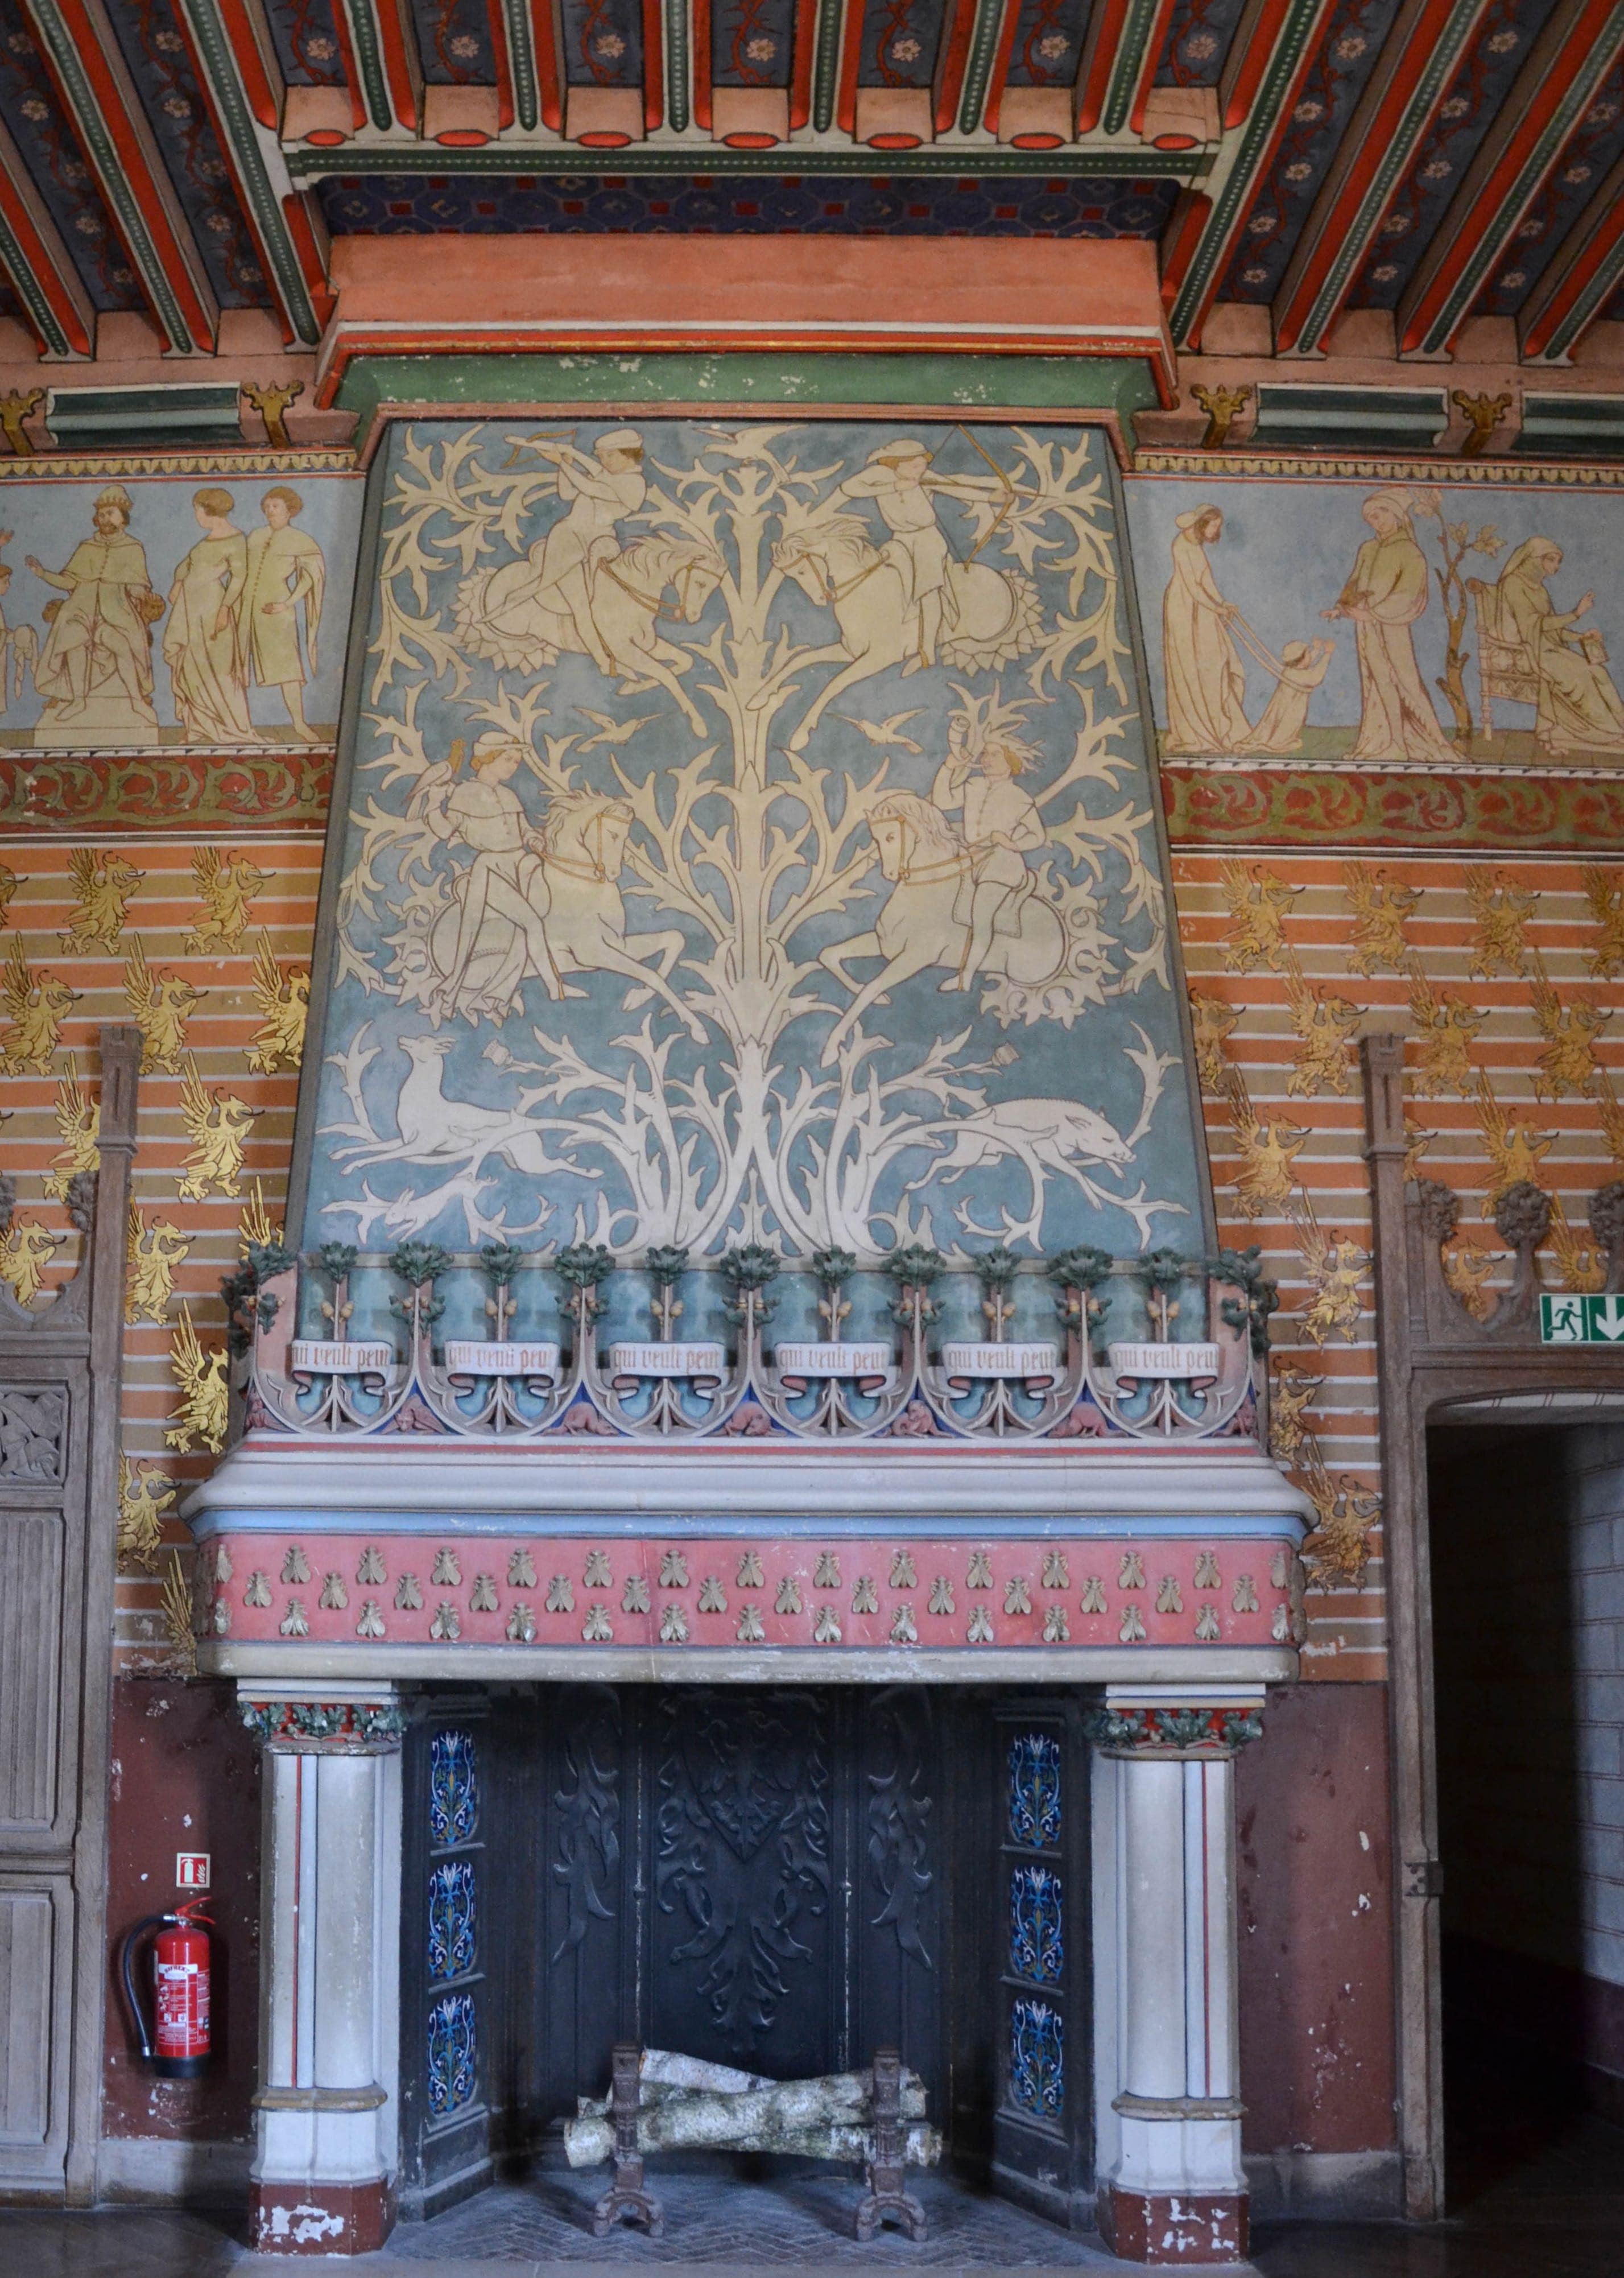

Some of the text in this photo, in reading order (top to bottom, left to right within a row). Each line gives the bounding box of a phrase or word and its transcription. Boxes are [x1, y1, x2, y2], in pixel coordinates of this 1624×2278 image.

[614, 1346, 720, 1375] qui veult peut
[809, 1346, 848, 1369] veult
[949, 1346, 1055, 1376] qui veult peut
[1143, 1345, 1180, 1369] veult
